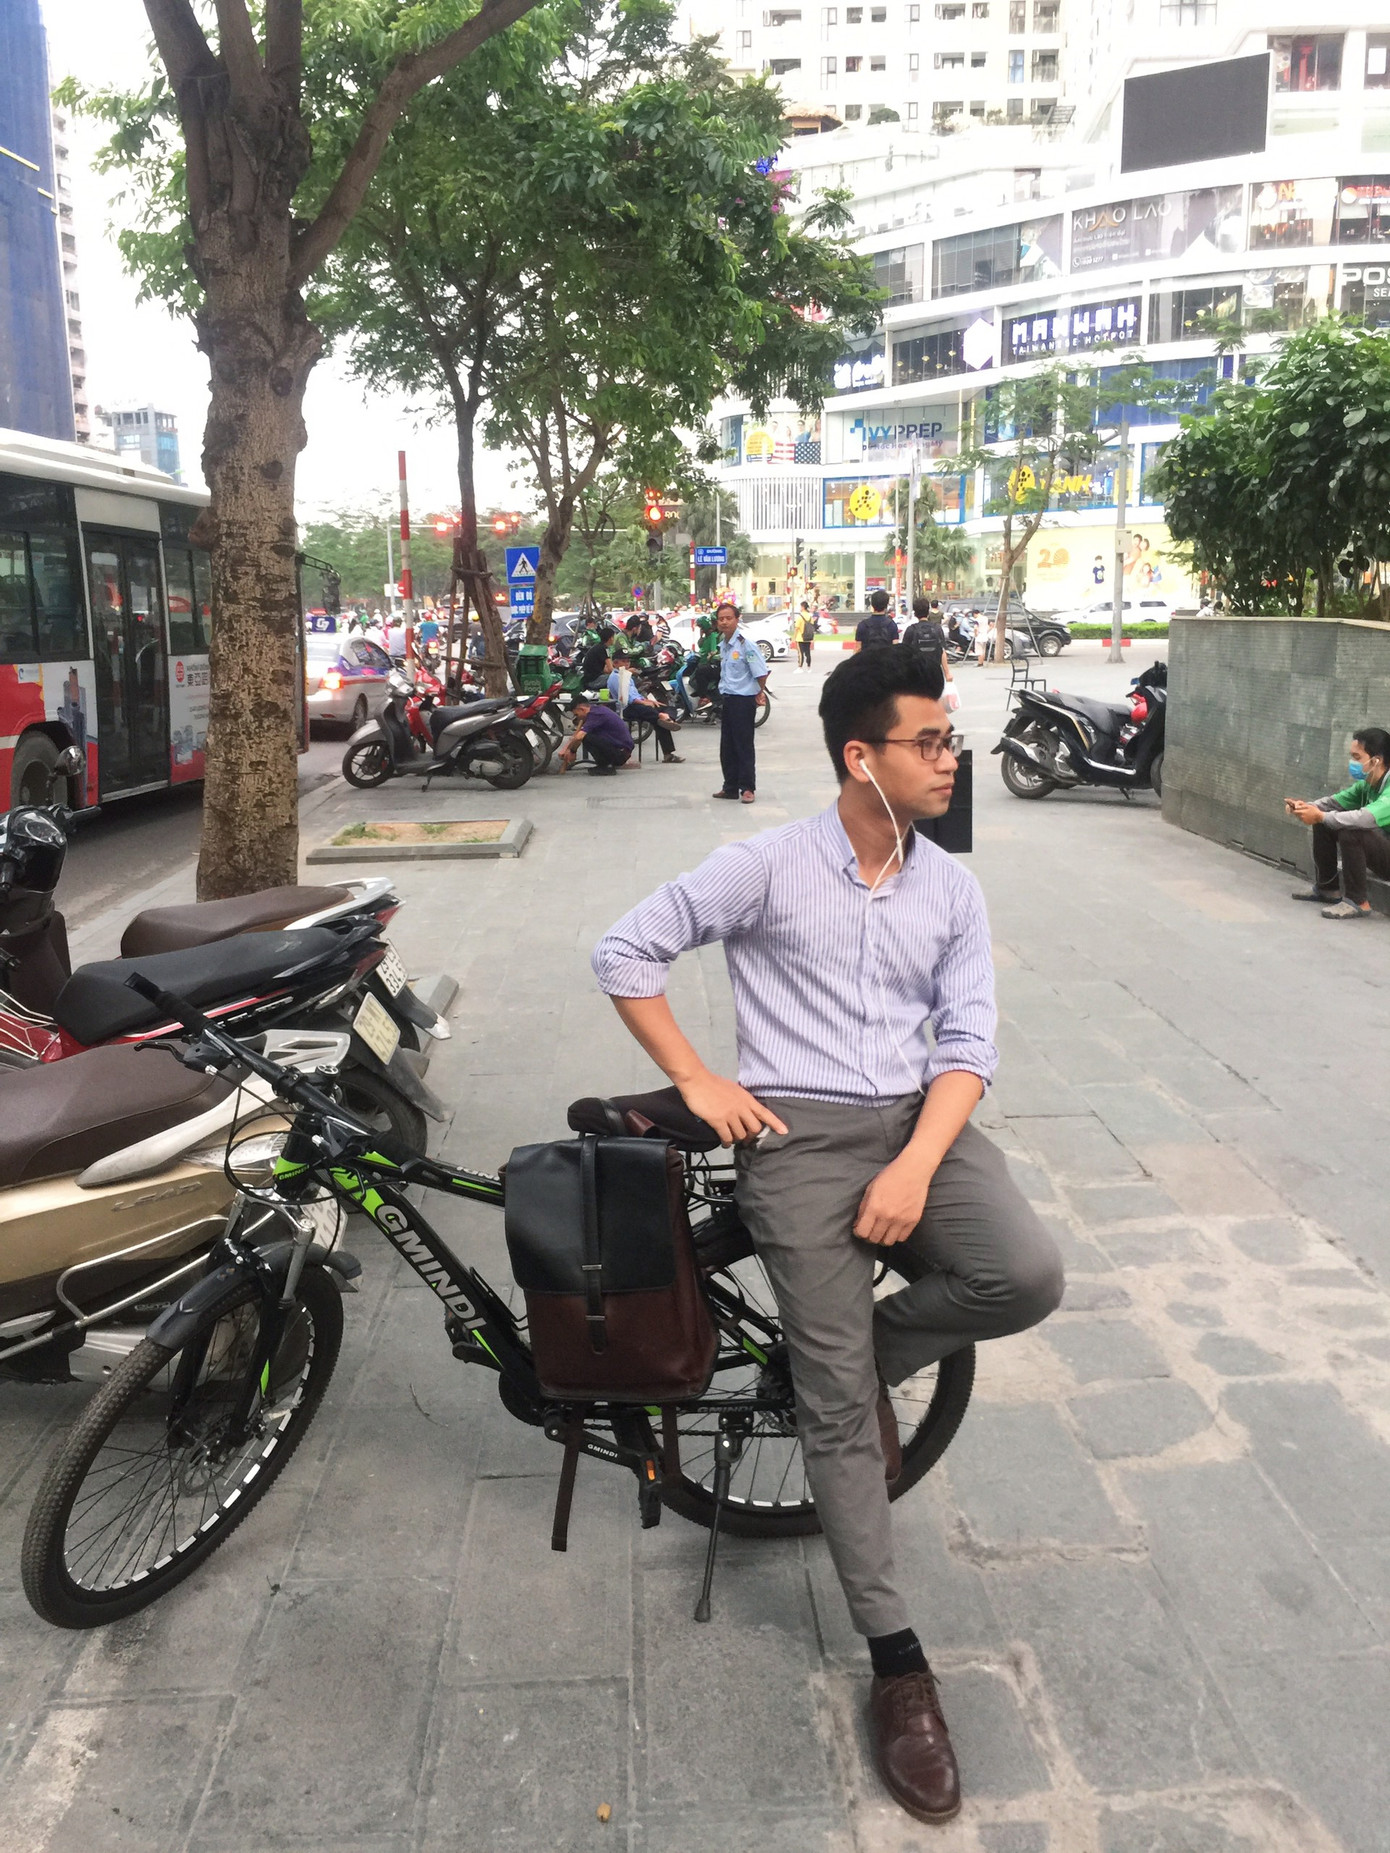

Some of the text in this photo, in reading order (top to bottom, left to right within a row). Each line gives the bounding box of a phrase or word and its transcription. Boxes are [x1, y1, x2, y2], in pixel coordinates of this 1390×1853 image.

[1340, 267, 1390, 286] PO
[1373, 287, 1390, 298] SE
[1084, 329, 1134, 345] HOTPOT
[375, 1204, 487, 1331] GMINDI
[586, 1443, 619, 1459] GMINDI
